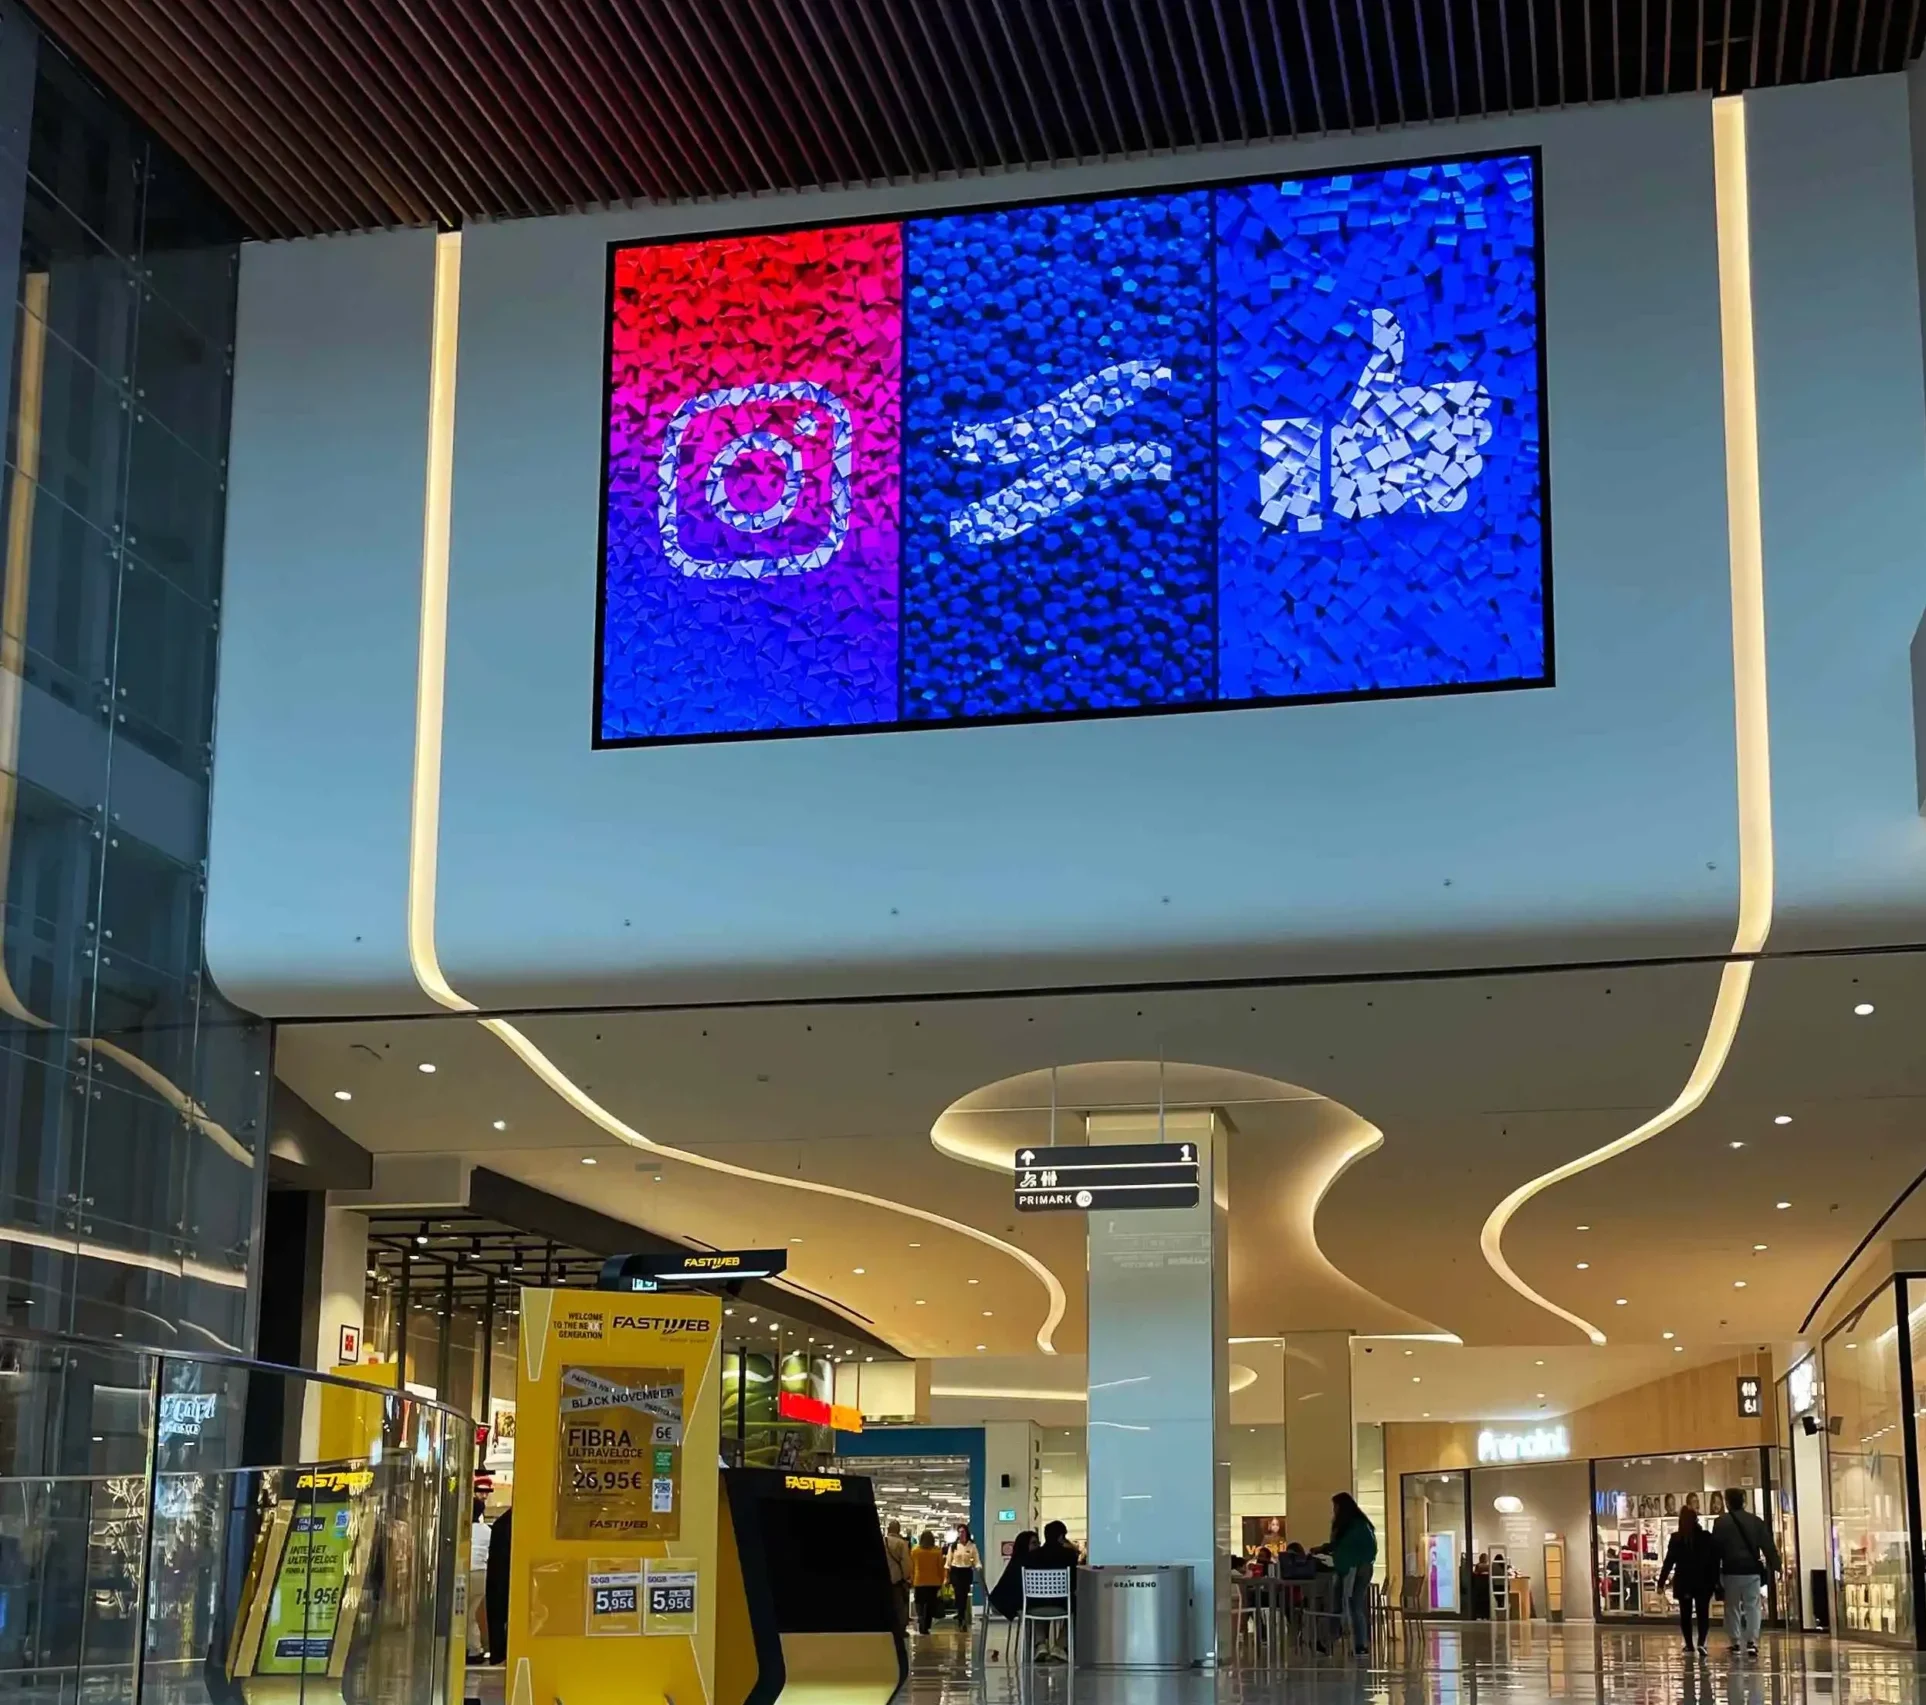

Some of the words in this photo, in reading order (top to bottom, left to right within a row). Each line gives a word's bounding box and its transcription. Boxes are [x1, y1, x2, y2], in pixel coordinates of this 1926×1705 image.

[1180, 1144, 1192, 1162] 1
[1019, 1194, 1073, 1205] PRIMARK
[684, 1256, 741, 1270] FASTWEB
[568, 1312, 604, 1321] WELCOME
[553, 1321, 563, 1329] TO
[564, 1321, 578, 1330] THE
[613, 1316, 710, 1335] FASTWEB
[558, 1330, 603, 1340] GENERATION
[572, 1396, 609, 1409] BLACK
[612, 1388, 675, 1405] NOVEMBER
[568, 1428, 633, 1448] FIBRA
[655, 1427, 673, 1440] 6€
[567, 1447, 644, 1458] ULTRAVELOCE
[572, 1471, 643, 1492] 26,95€
[589, 1520, 649, 1531] FASTWEB
[290, 1545, 328, 1555] INTENET
[596, 1591, 635, 1612] 5,95€
[653, 1591, 691, 1612] 5,95€
